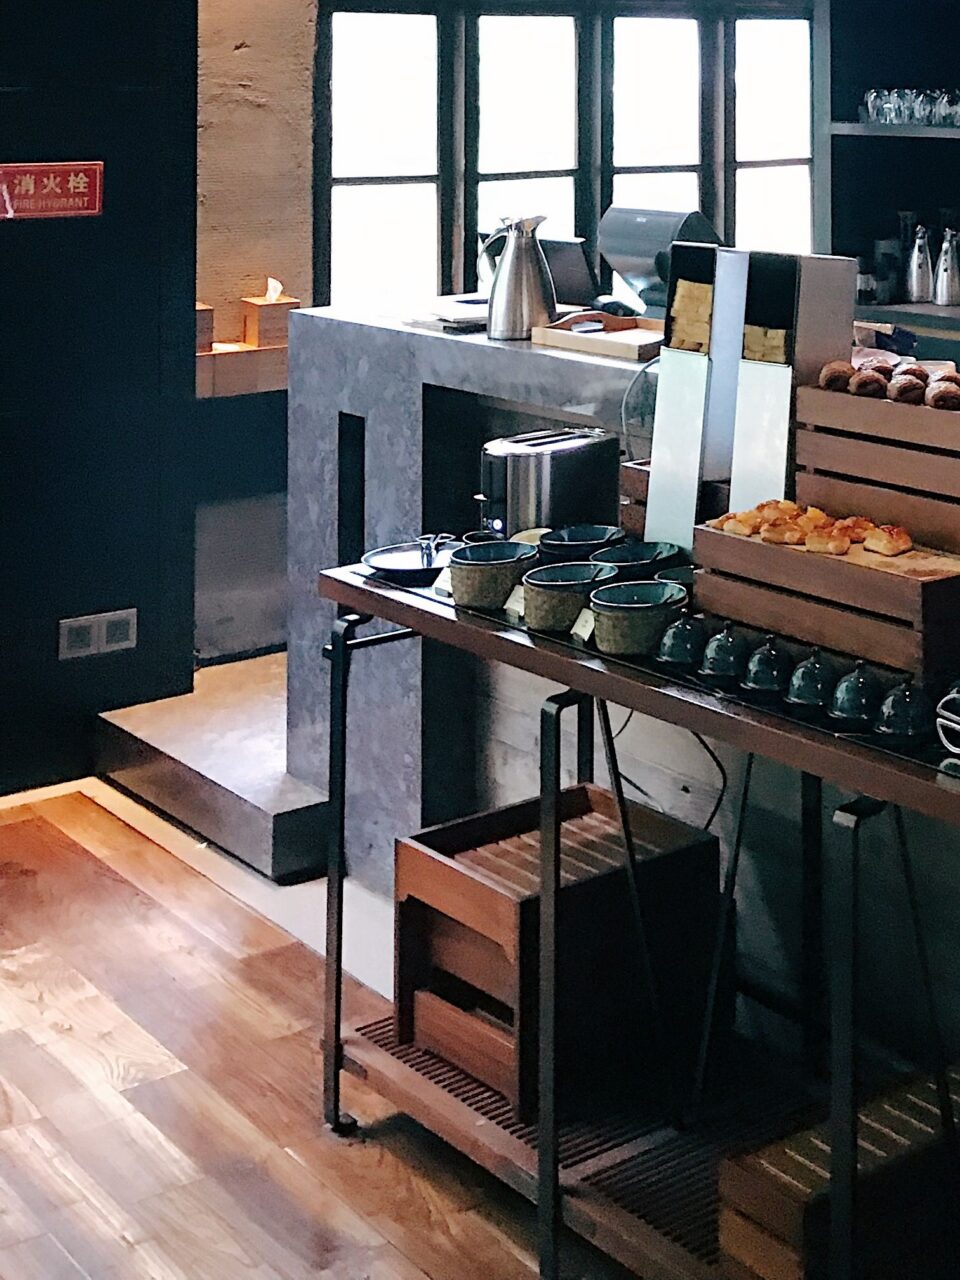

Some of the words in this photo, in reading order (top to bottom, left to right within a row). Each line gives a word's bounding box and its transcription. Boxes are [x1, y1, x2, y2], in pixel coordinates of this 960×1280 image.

[13, 172, 89, 194] 消火栓
[13, 199, 35, 209] FIRE
[39, 197, 89, 209] HYDRANT
